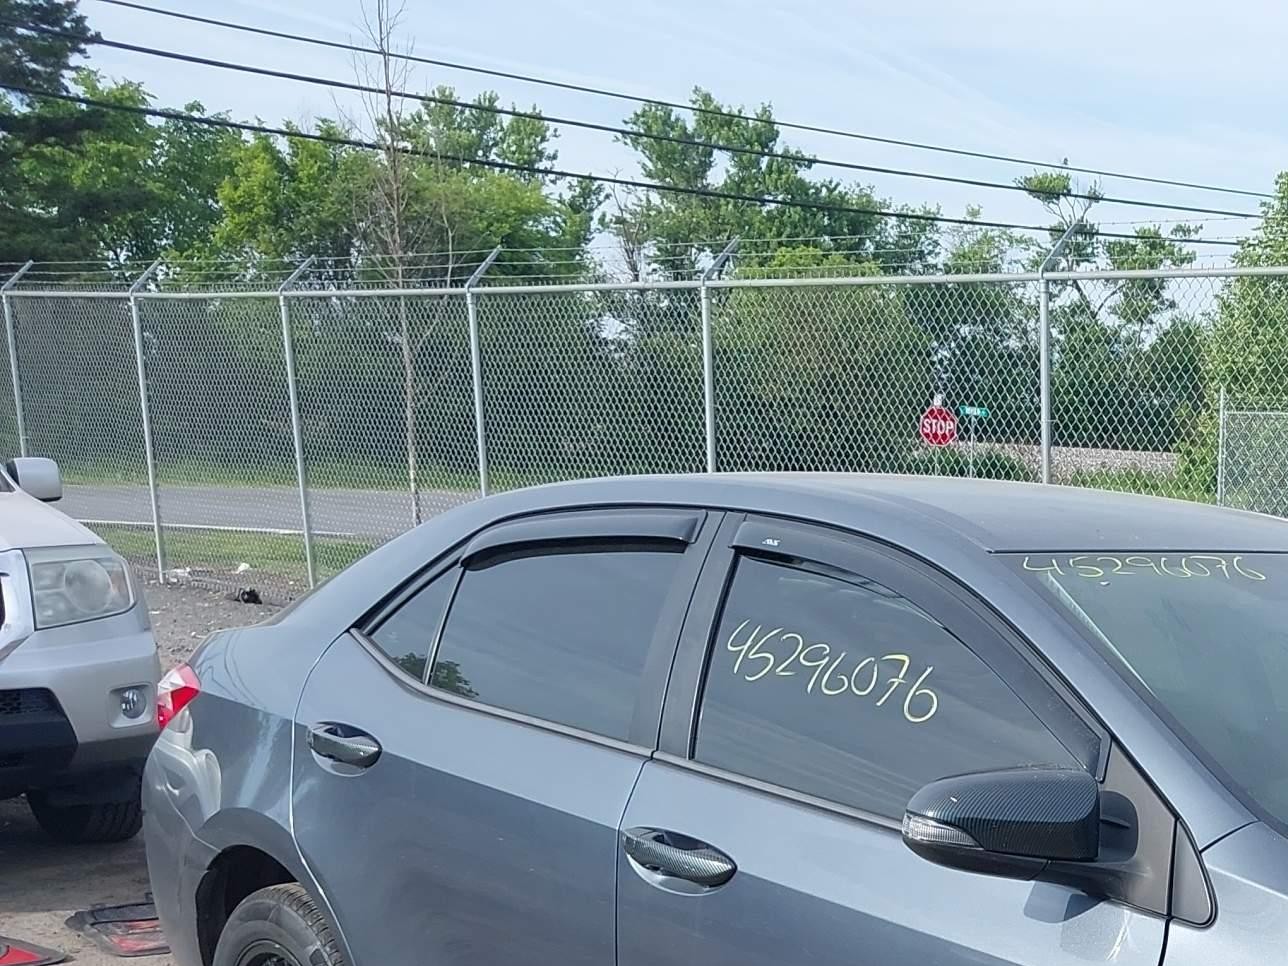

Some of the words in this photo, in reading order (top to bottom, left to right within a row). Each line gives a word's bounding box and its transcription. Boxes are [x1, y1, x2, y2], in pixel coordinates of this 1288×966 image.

[923, 418, 954, 434] STOP
[1023, 556, 1267, 580] 45296076
[727, 618, 938, 722] 45296076
